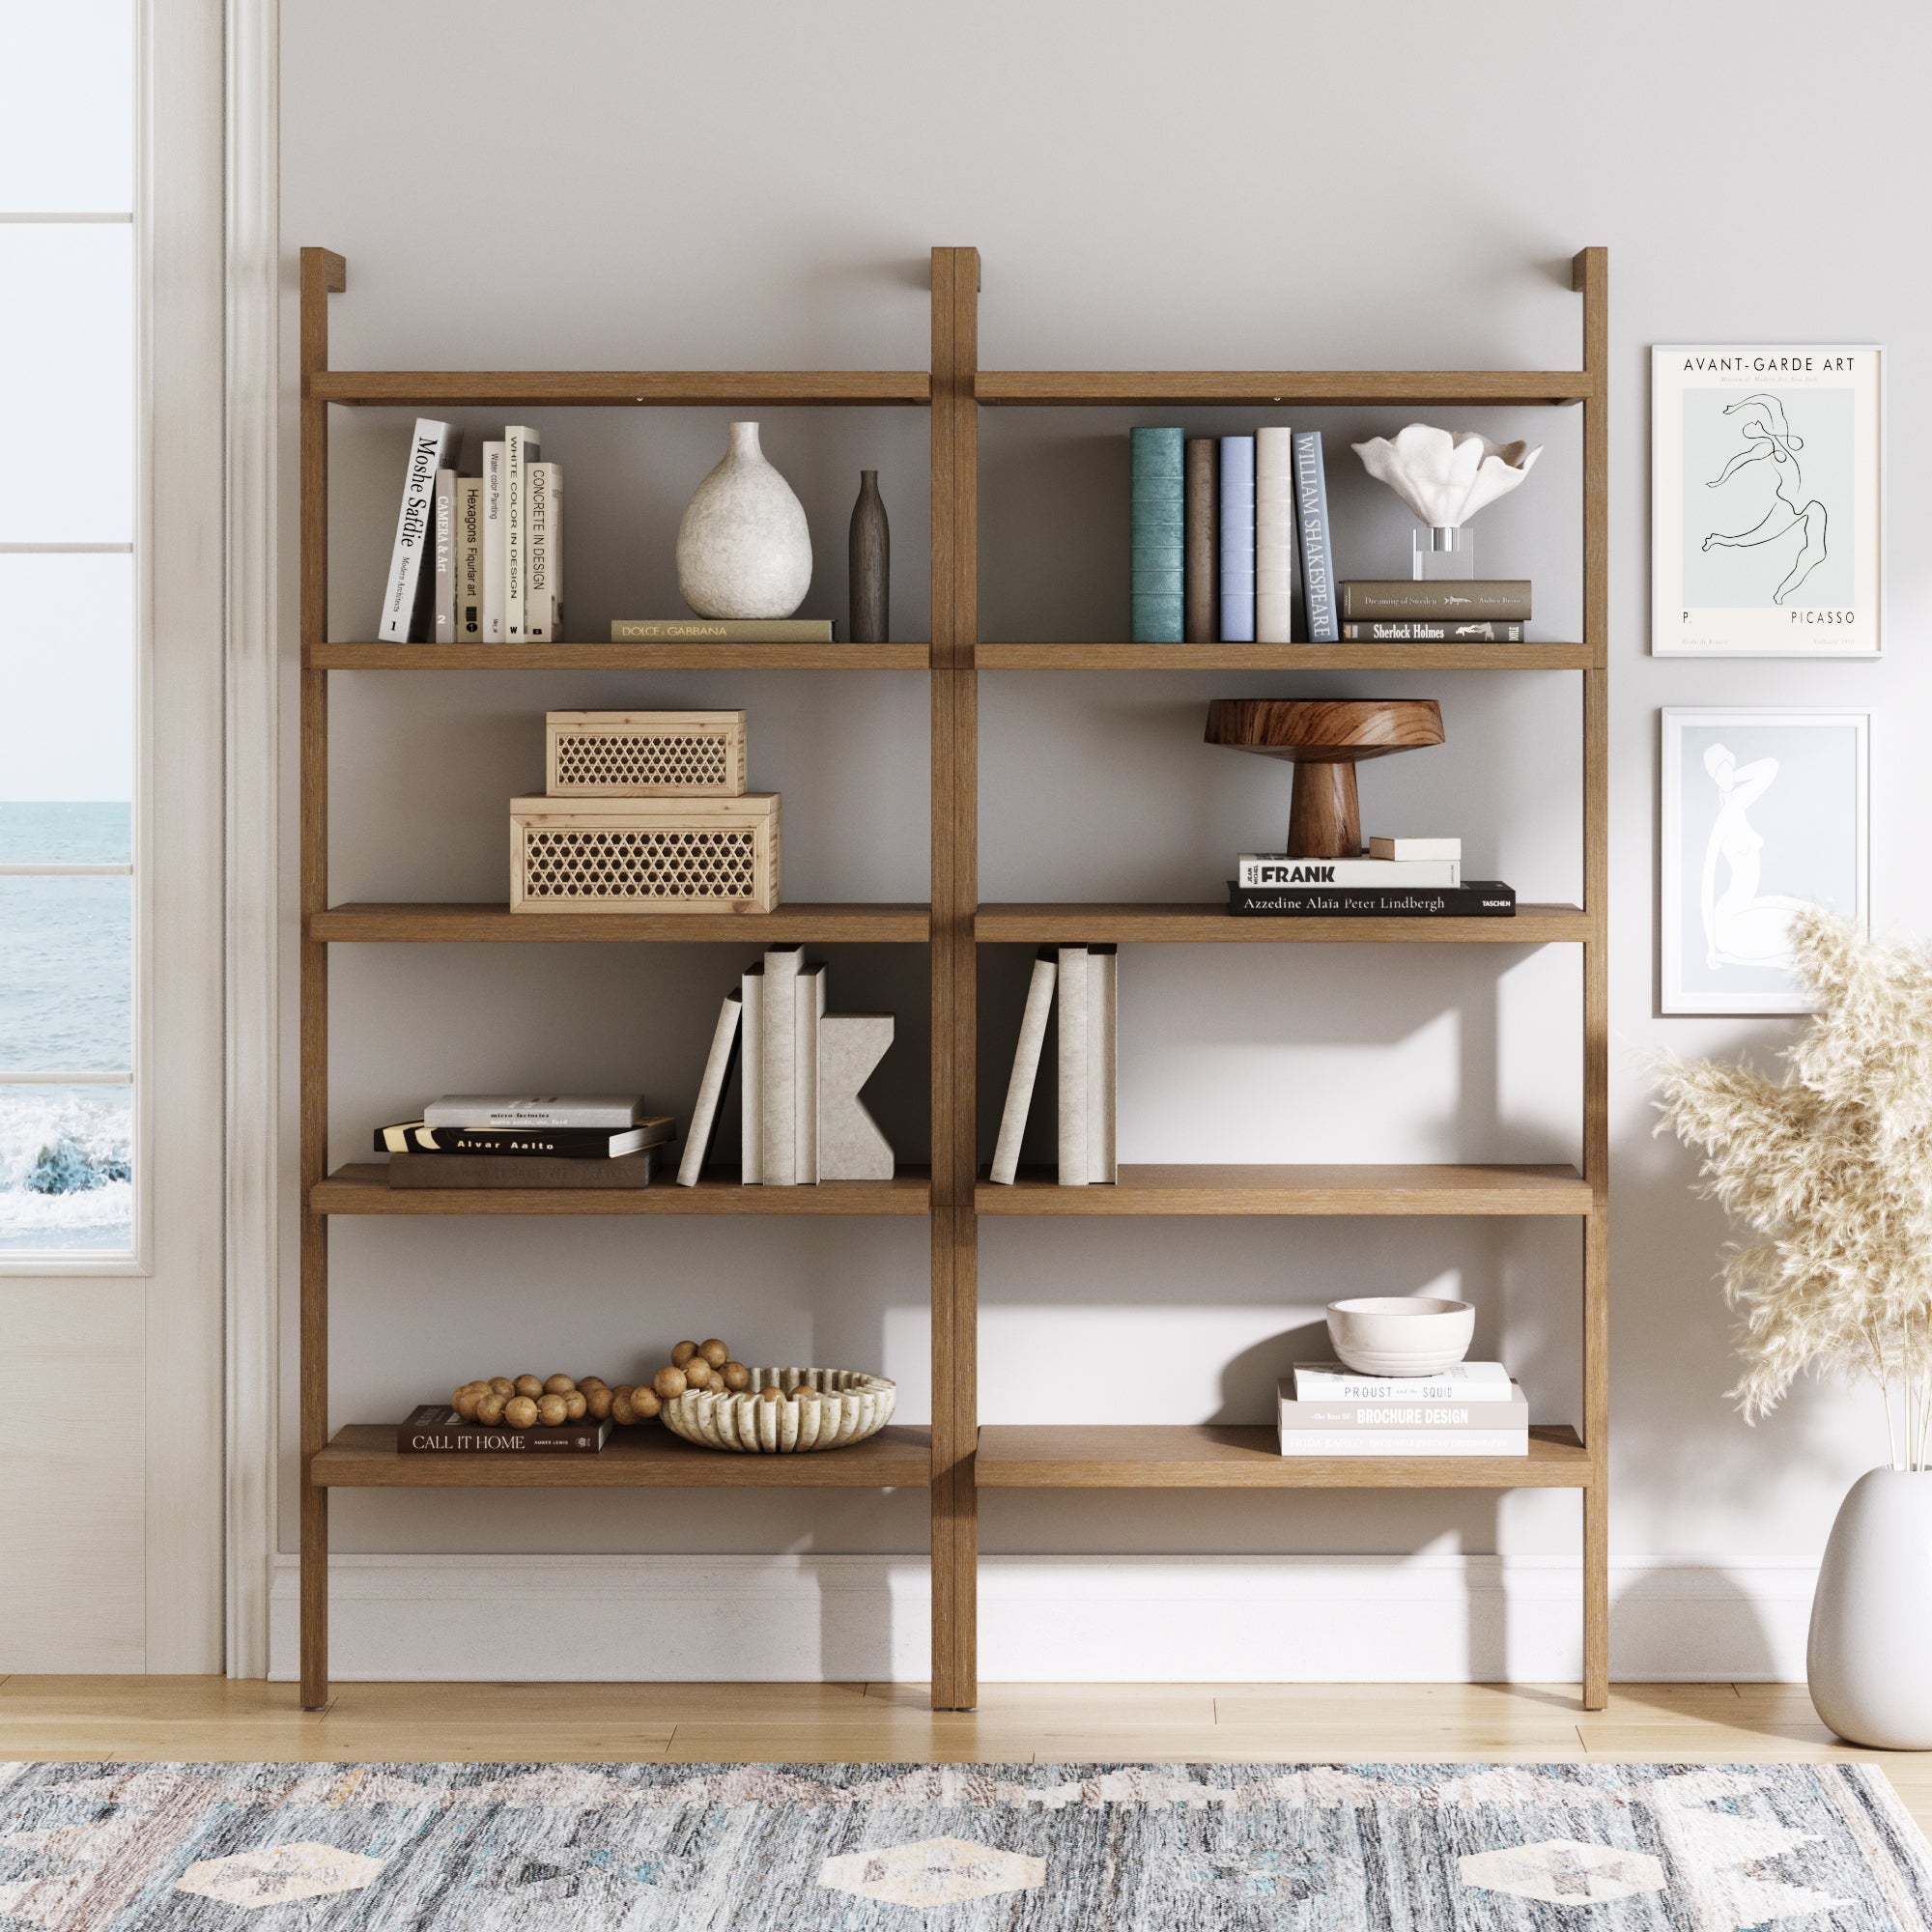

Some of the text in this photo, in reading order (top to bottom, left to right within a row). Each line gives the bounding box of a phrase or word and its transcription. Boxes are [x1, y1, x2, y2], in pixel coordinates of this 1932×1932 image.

[1684, 357, 1854, 371] AVANT-GARDE ART
[401, 437, 438, 548] Moshe Safdie
[489, 453, 499, 520] Water color Painting
[465, 489, 479, 543] Hexagons
[438, 496, 448, 572] CAMERA & Art
[533, 469, 545, 590] CONCRETE IN DESIGN
[1297, 435, 1331, 638] WILLIAM SHAKESPEARE
[510, 532, 517, 545] IN
[393, 556, 411, 612] Modern Architects
[467, 583, 477, 596] art
[1365, 596, 1400, 607] Dreaming
[1409, 596, 1437, 605] Sweden
[438, 614, 446, 624] 2
[1791, 611, 1855, 624] PICASSO
[622, 626, 659, 636] DOLCE
[667, 626, 727, 637] GABBANA
[1373, 624, 1445, 639] Sherlock Holmes
[1262, 867, 1335, 883] FRANK
[1244, 896, 1445, 913] Azzedine Alaïa Peter Lindbergh
[457, 1140, 554, 1150] Alvar Aalto
[1344, 1386, 1392, 1398] PROUST
[1422, 1386, 1453, 1398] SQUID
[1357, 1408, 1422, 1424] BROCHURE
[1425, 1408, 1468, 1424] DESIGN
[412, 1435, 526, 1449] CALL IT HOME
